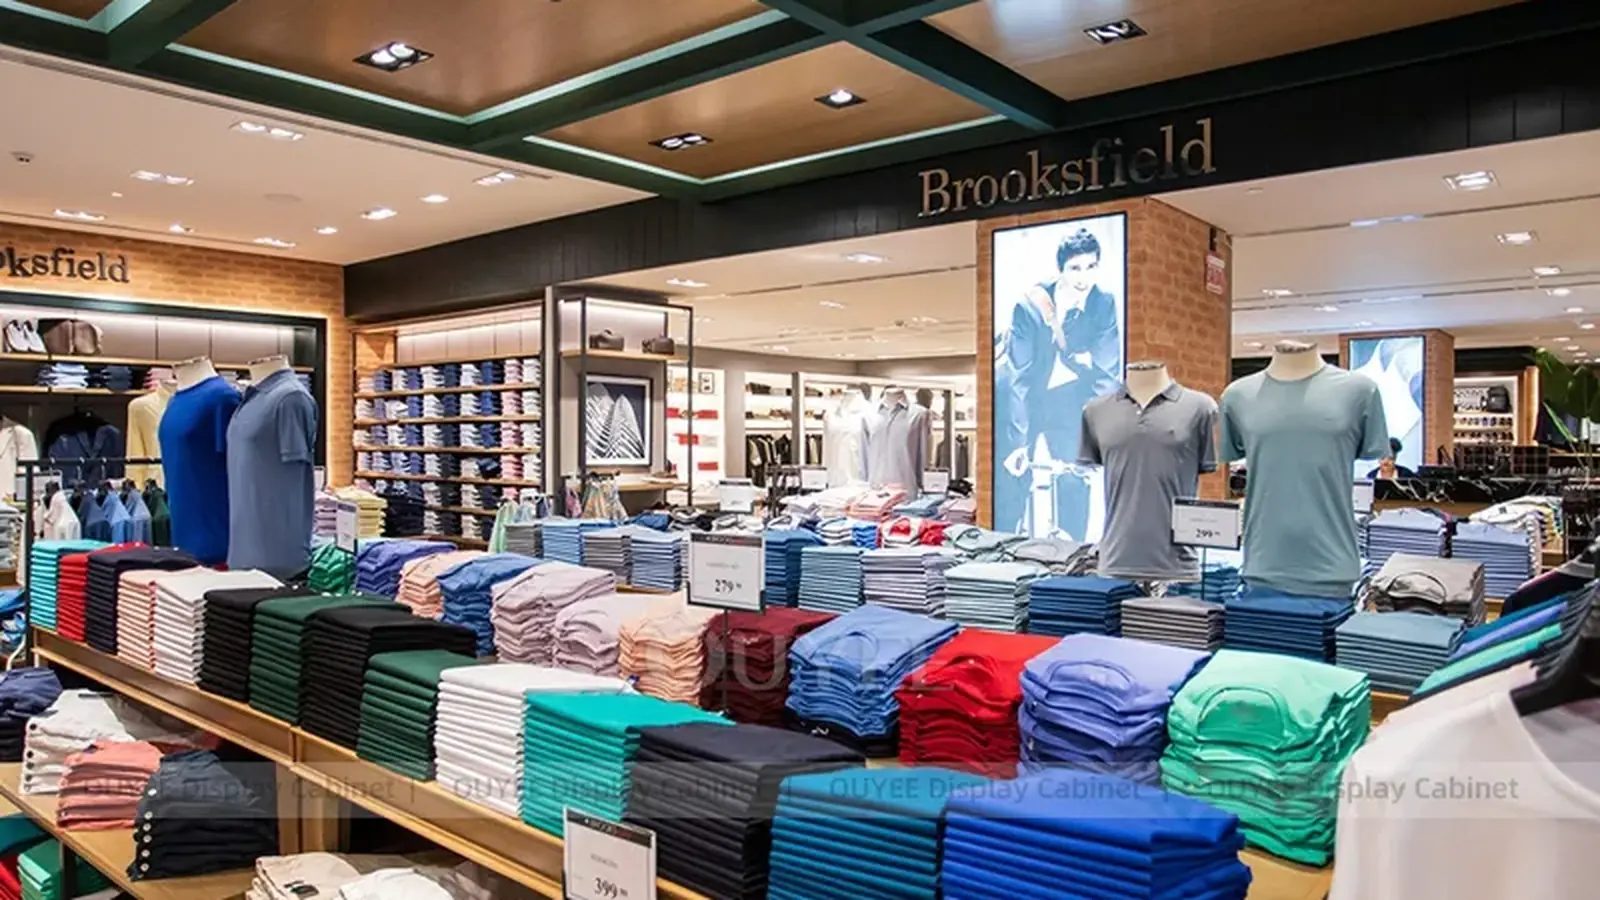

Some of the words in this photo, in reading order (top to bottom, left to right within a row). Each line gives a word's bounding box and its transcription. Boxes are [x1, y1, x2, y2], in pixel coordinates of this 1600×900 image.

[917, 118, 1217, 218] Brooksfield
[715, 579, 734, 596] 279
[593, 877, 618, 899] 399
